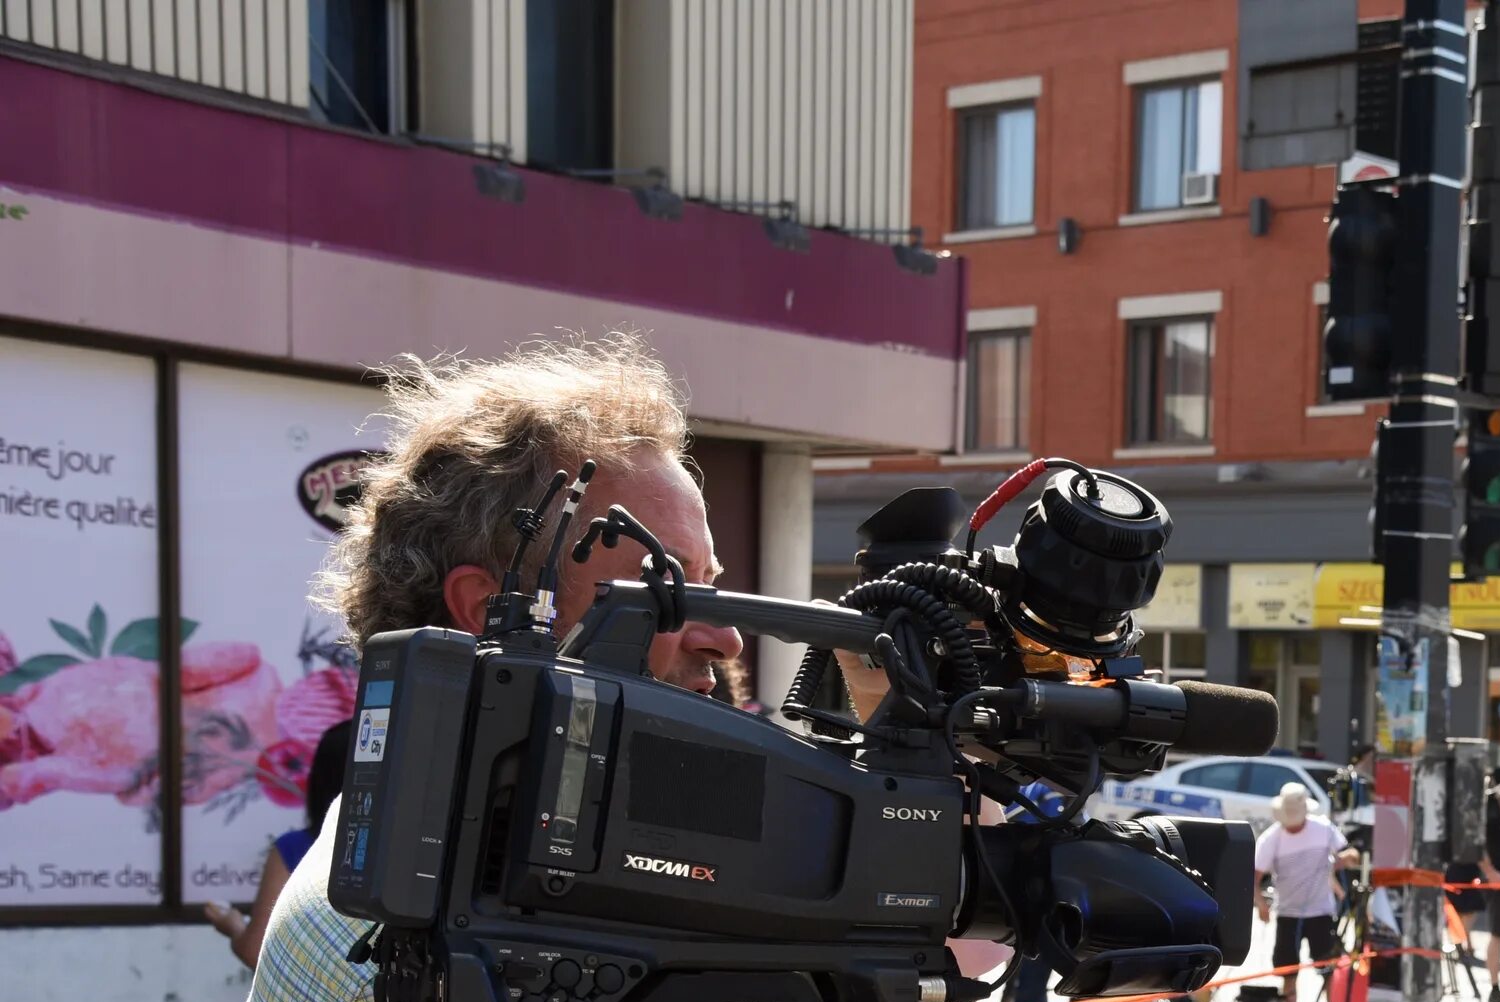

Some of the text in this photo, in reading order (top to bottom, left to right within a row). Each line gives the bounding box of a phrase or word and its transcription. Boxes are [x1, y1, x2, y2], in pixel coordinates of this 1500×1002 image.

[47, 440, 116, 480] jour
[66, 494, 156, 530] qualité
[882, 806, 942, 821] SONY
[38, 862, 110, 890] Same
[192, 862, 262, 887] delive
[624, 854, 715, 882] XDCAM EX
[884, 894, 934, 907] Exmor
